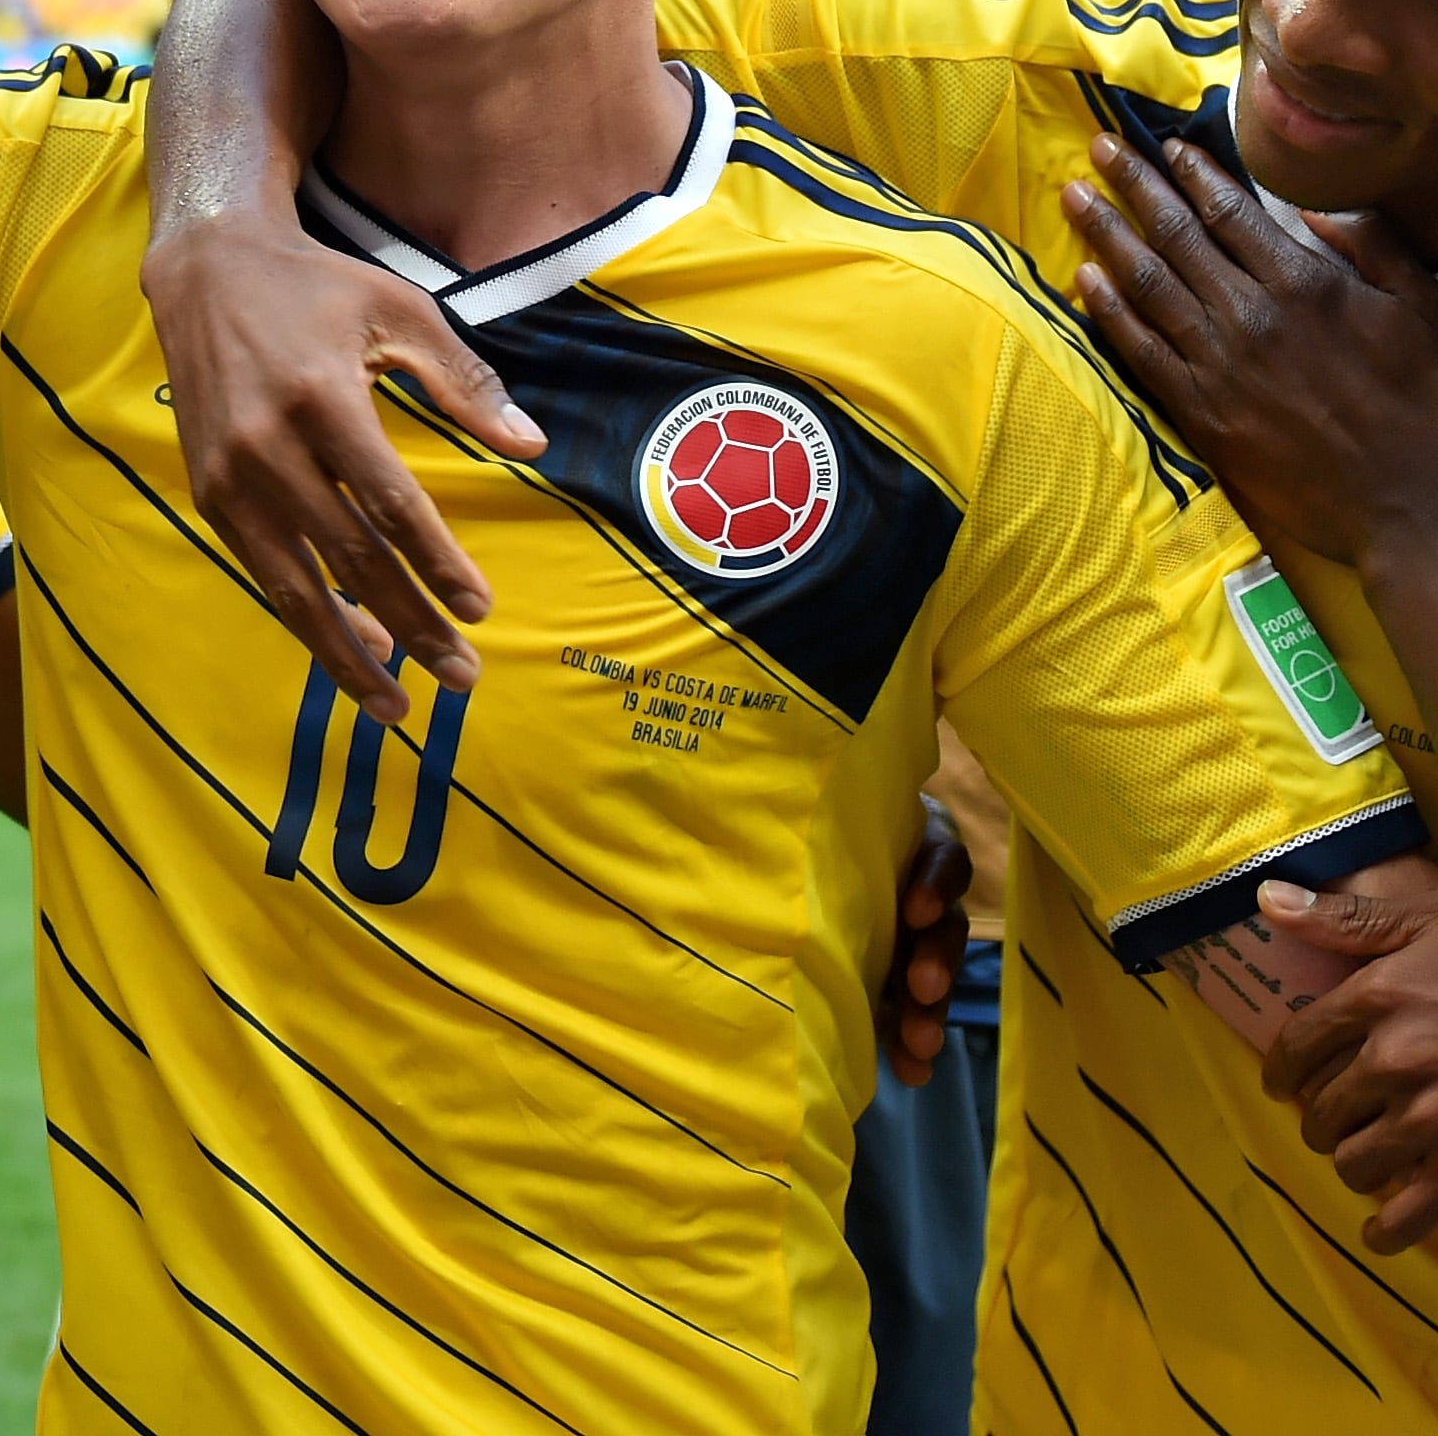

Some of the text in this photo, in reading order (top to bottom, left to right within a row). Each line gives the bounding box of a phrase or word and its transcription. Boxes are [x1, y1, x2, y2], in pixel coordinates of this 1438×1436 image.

[650, 389, 832, 493] FEDERACION COLOMBIANA DE FUTBOL
[1261, 607, 1306, 637] FOOTB
[1271, 621, 1317, 653] FOR HO
[561, 646, 789, 713] COLOMBIA VS COSTA DE MARFIL
[622, 690, 725, 731] 19 JUNIO 2014
[265, 588, 473, 905] 10
[631, 720, 700, 753] BRASILIA
[1389, 723, 1434, 753] COLO
